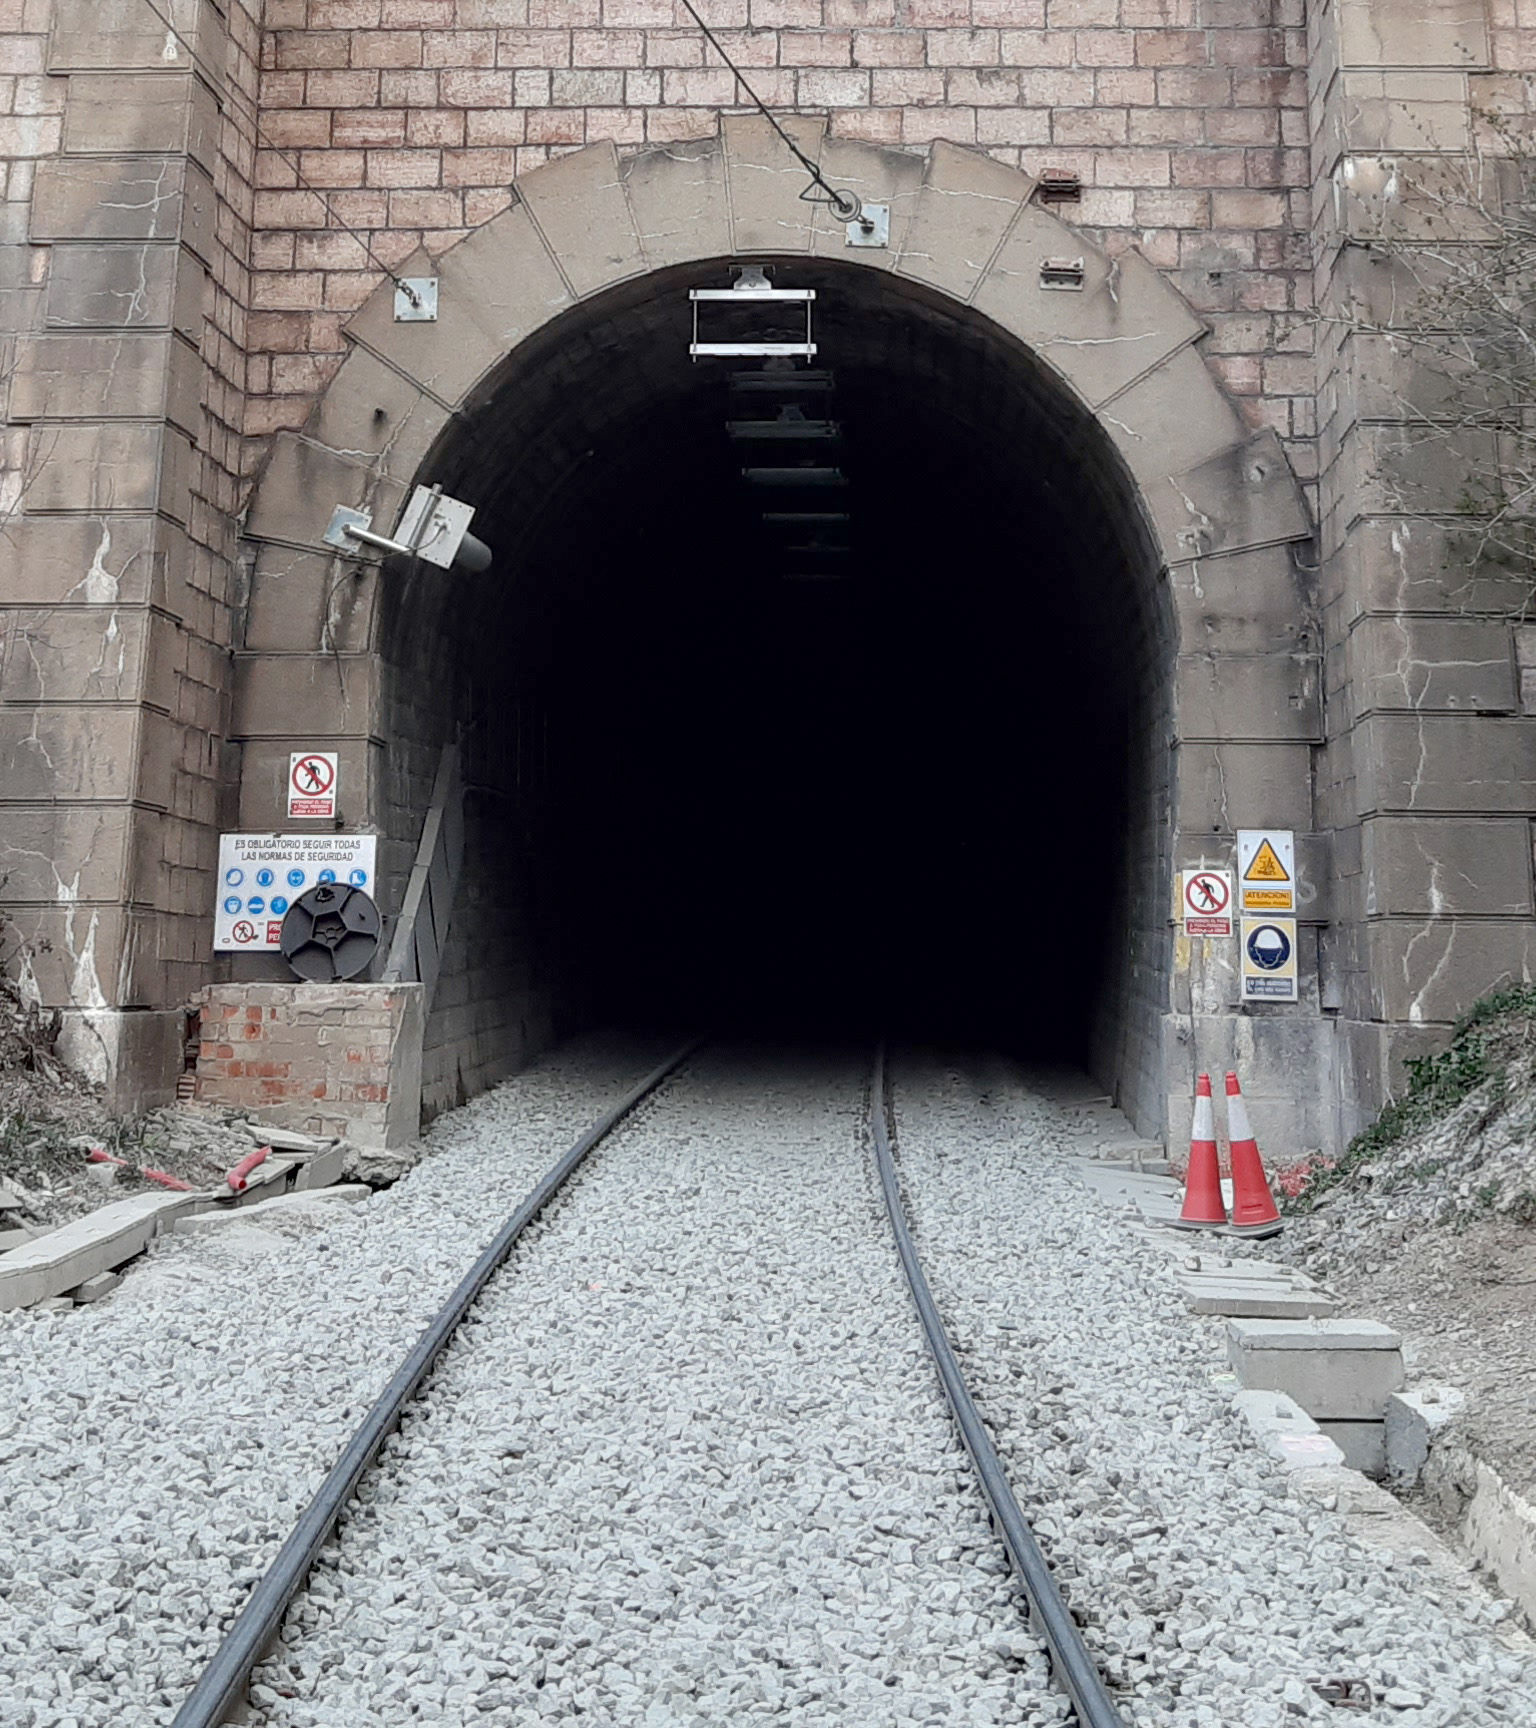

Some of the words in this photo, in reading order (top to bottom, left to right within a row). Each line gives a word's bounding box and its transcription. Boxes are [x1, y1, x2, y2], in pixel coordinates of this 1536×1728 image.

[235, 839, 246, 850] ES
[247, 839, 301, 849] OBLIGATORIO
[302, 839, 332, 849] SEGUIR
[334, 840, 361, 850] TODAS
[241, 852, 257, 861] LAS
[258, 852, 293, 861] NORMAS
[294, 852, 305, 861] DE
[307, 852, 353, 862] SEGURIDAD
